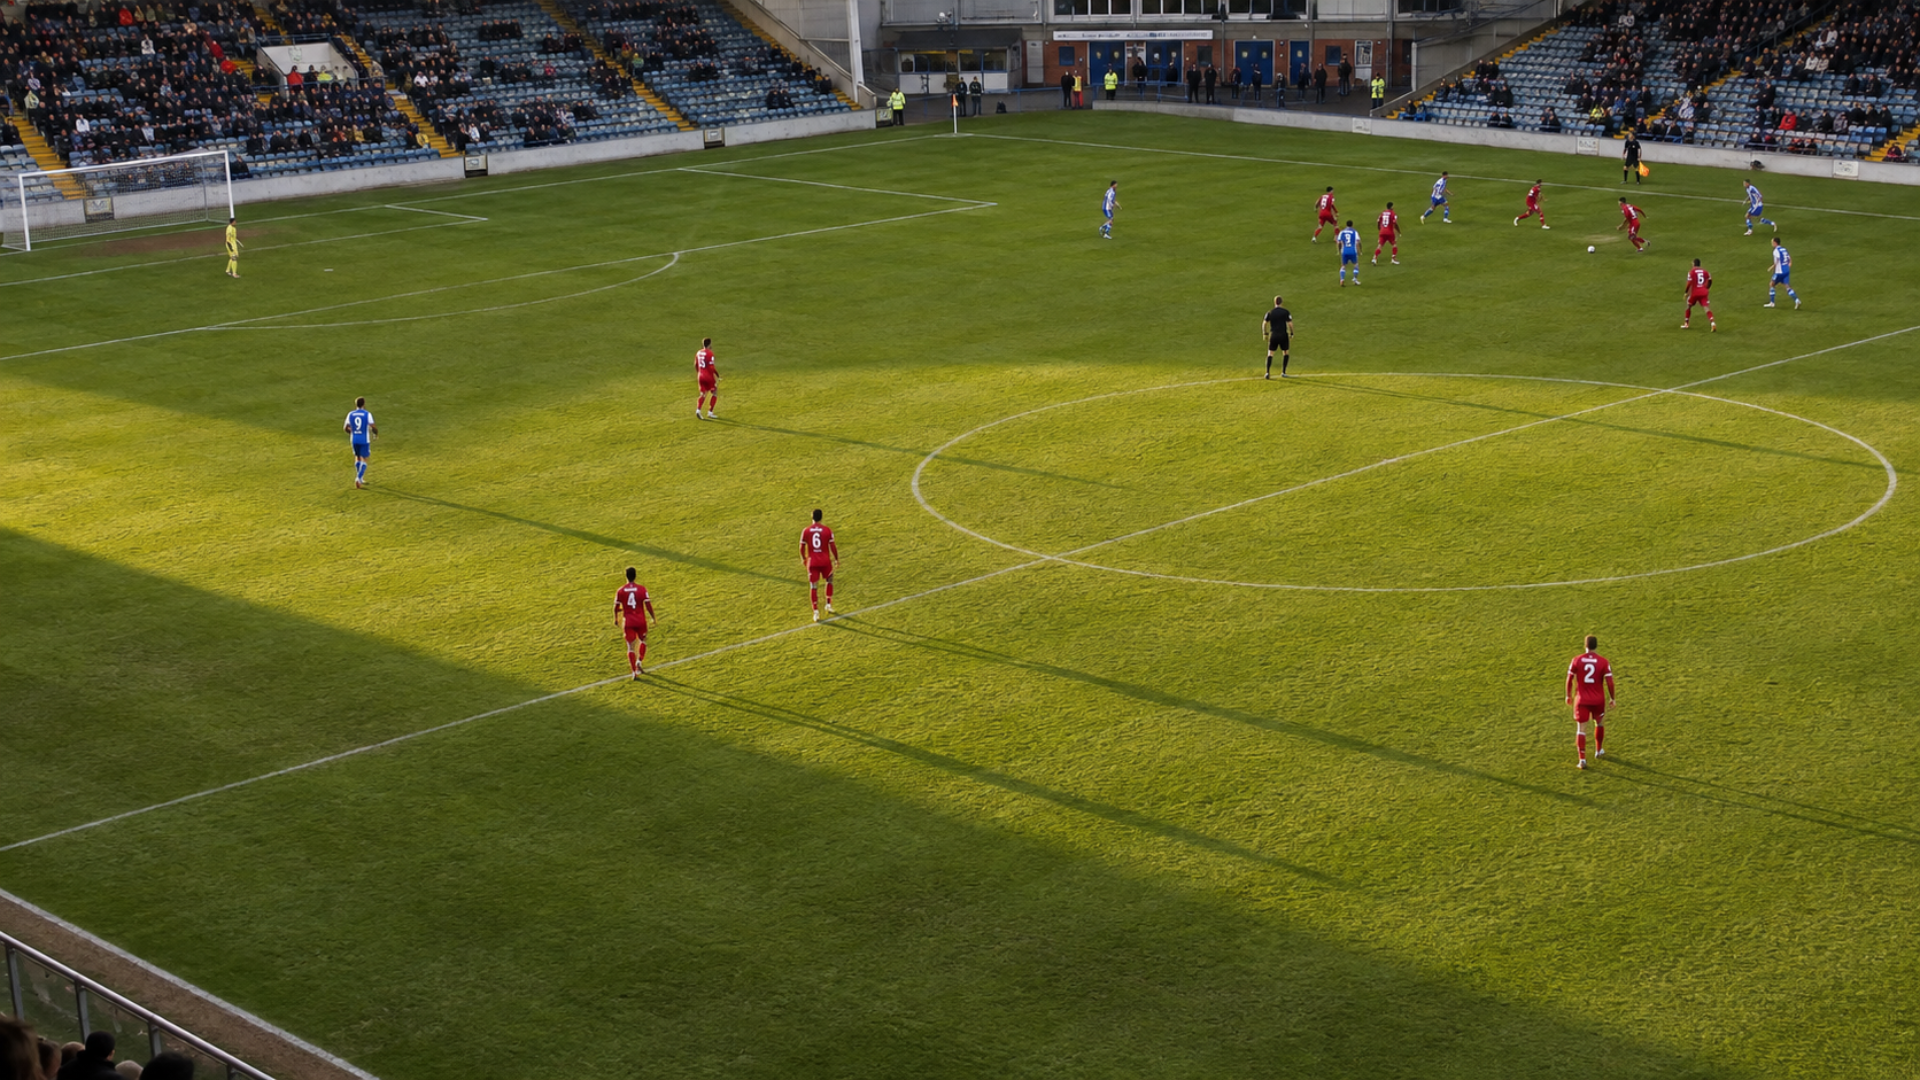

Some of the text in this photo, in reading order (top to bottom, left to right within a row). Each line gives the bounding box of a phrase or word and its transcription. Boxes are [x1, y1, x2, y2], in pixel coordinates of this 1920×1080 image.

[355, 416, 362, 430] 9
[812, 532, 821, 549] 6
[627, 592, 636, 609] 4
[1584, 663, 1595, 683] 2
